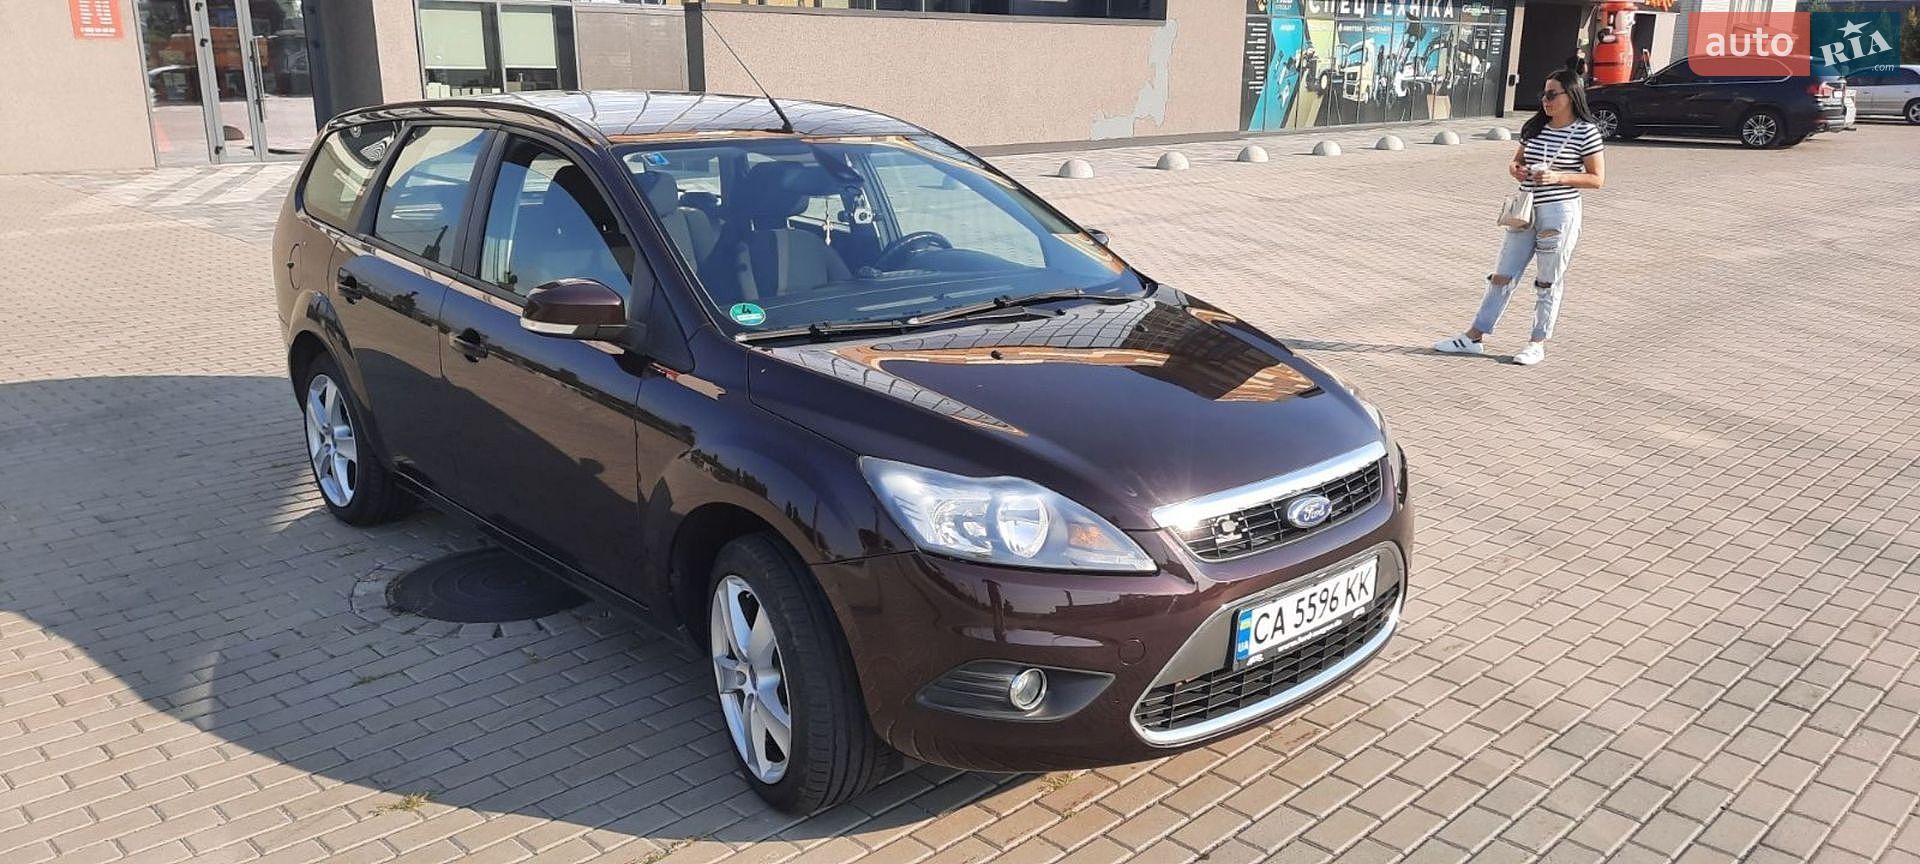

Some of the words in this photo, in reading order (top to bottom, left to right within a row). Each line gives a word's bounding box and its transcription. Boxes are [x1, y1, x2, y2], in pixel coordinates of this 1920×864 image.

[1303, 503, 1325, 521] Ford
[1254, 606, 1285, 644] CA
[1293, 581, 1340, 629] 5596
[1344, 566, 1371, 606] KK
